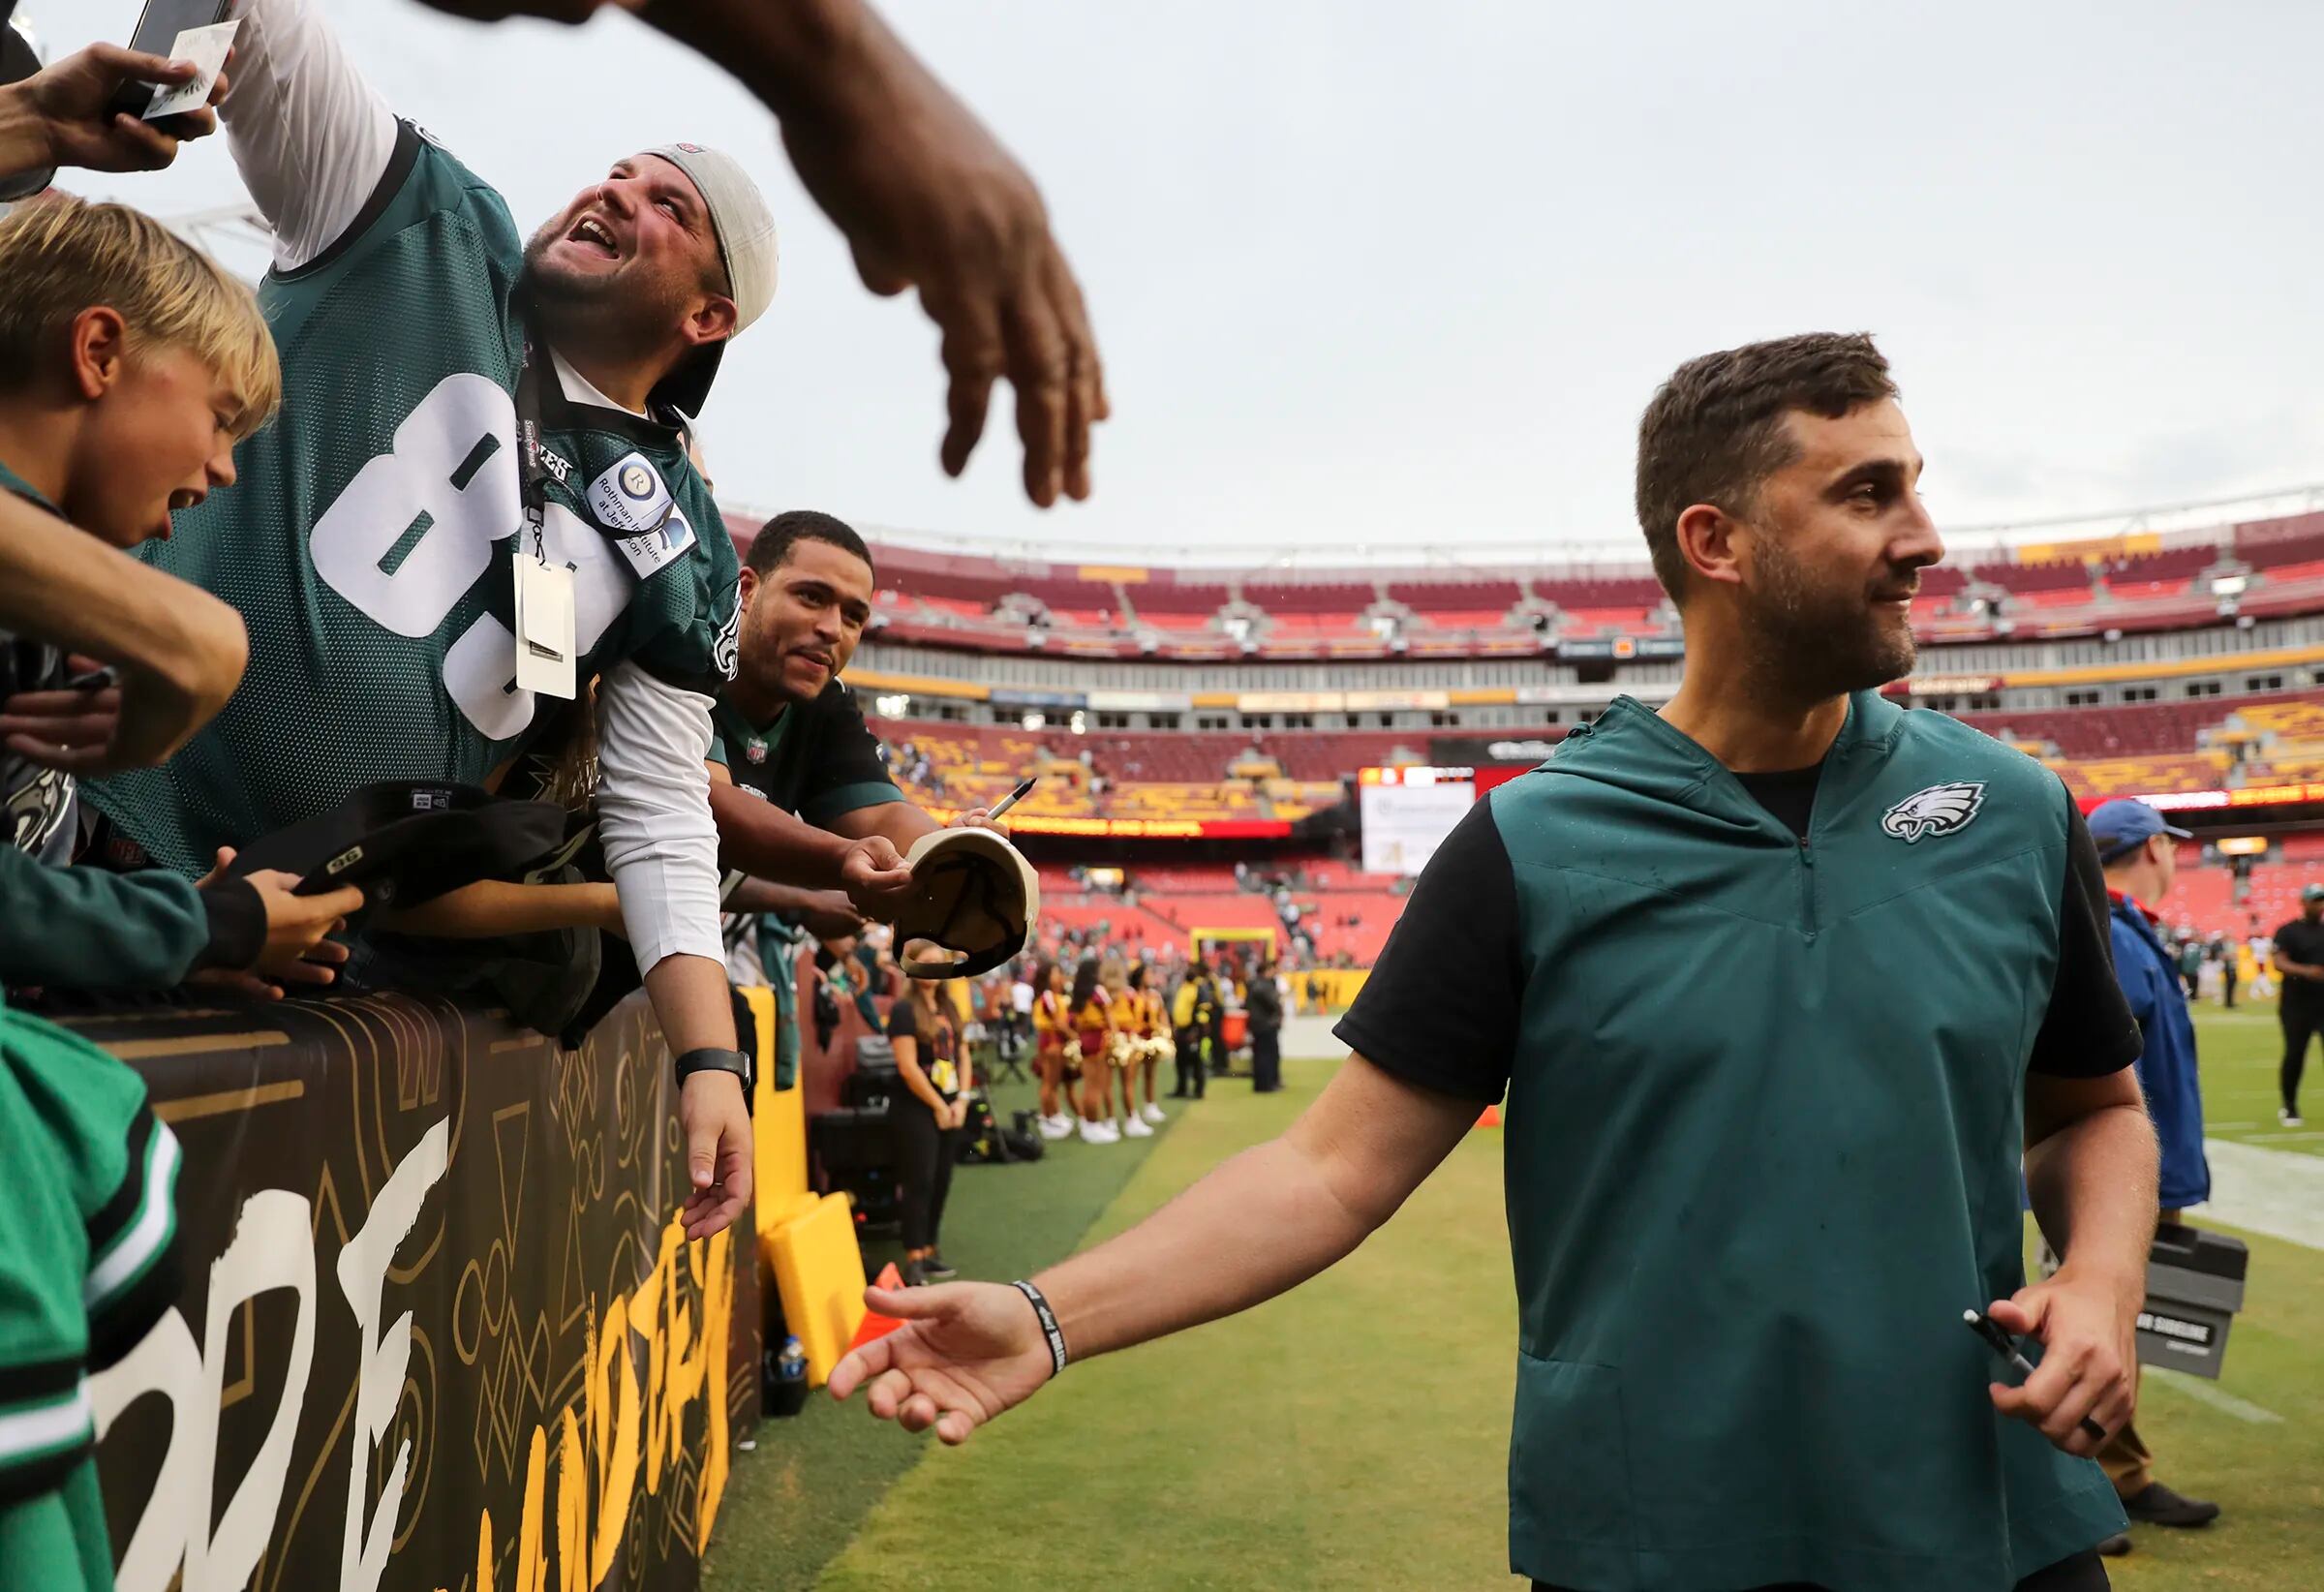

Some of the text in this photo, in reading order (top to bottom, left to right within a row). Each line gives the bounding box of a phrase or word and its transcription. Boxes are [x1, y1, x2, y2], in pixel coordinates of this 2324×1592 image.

[598, 477, 661, 565] Rothman Intitute
[598, 500, 643, 557] at Jeffson
